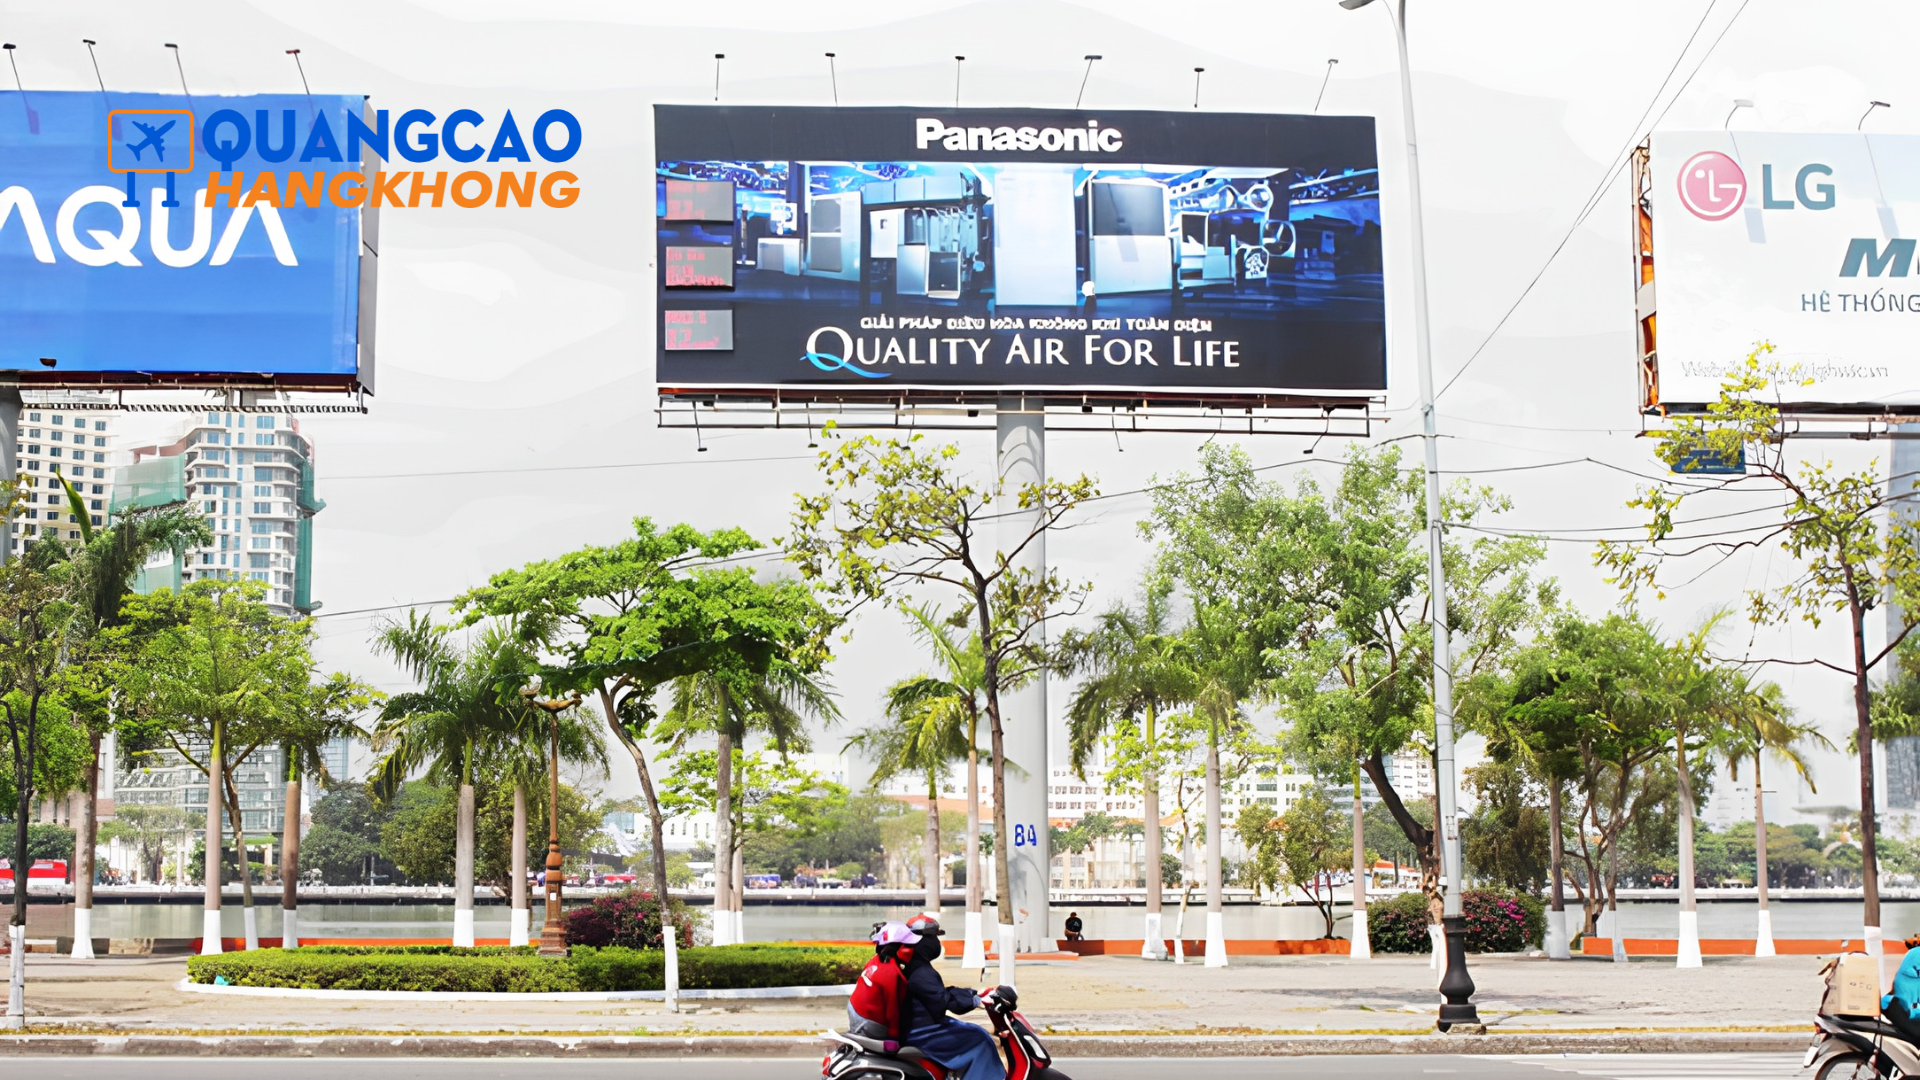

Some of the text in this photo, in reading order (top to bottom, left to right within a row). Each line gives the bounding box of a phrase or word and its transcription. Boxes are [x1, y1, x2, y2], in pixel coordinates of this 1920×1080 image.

[916, 118, 1123, 152] Panasonic
[1762, 163, 1836, 211] LG
[1838, 238, 1920, 278] M
[804, 326, 1240, 378] QUALITY AIR FOR LIFE
